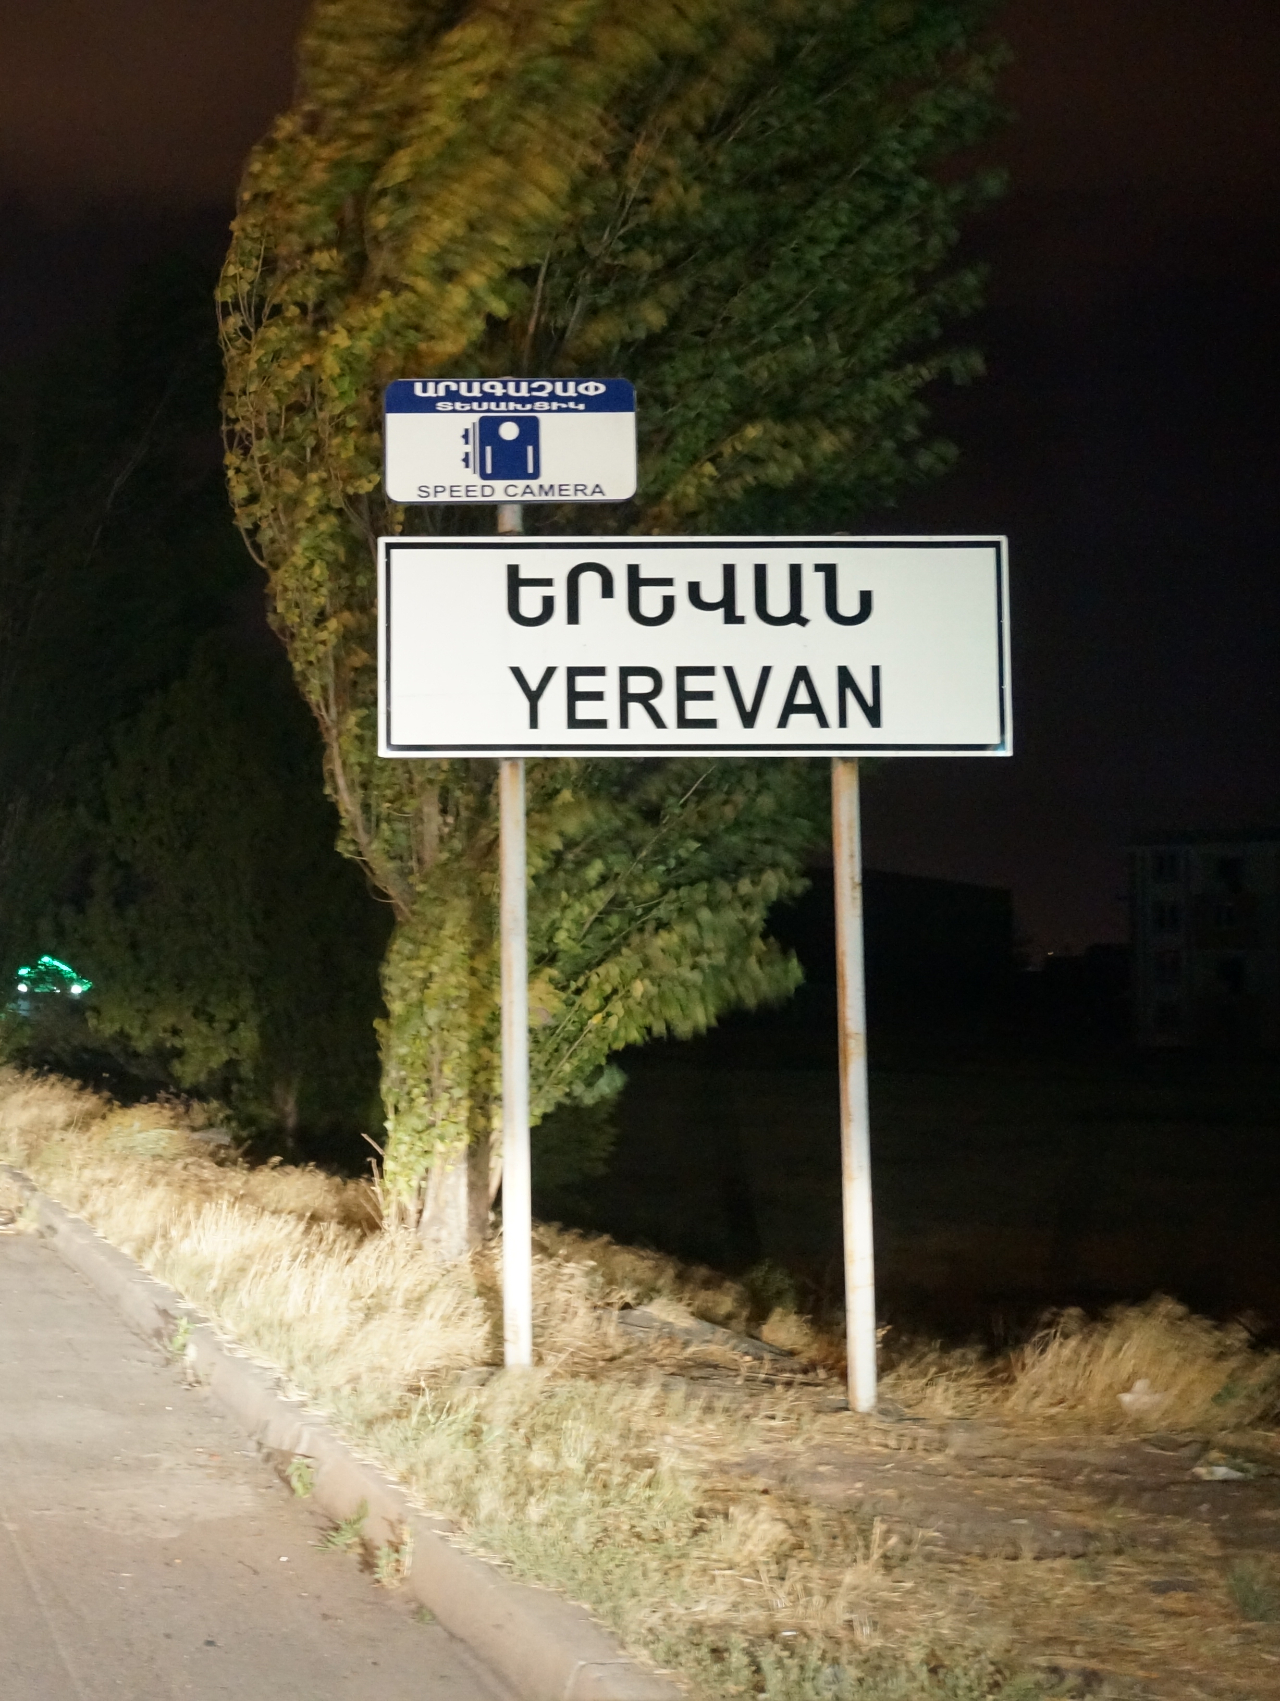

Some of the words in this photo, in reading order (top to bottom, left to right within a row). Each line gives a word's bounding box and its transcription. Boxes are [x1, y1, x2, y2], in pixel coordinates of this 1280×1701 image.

[413, 381, 606, 398] ԱՐԱԳԱՉԱՓ
[417, 484, 496, 499] SPEED
[503, 483, 606, 498] CAMERA
[506, 561, 874, 628] ԵՐԵՎԱՆ
[508, 664, 883, 730] YEREVAN
